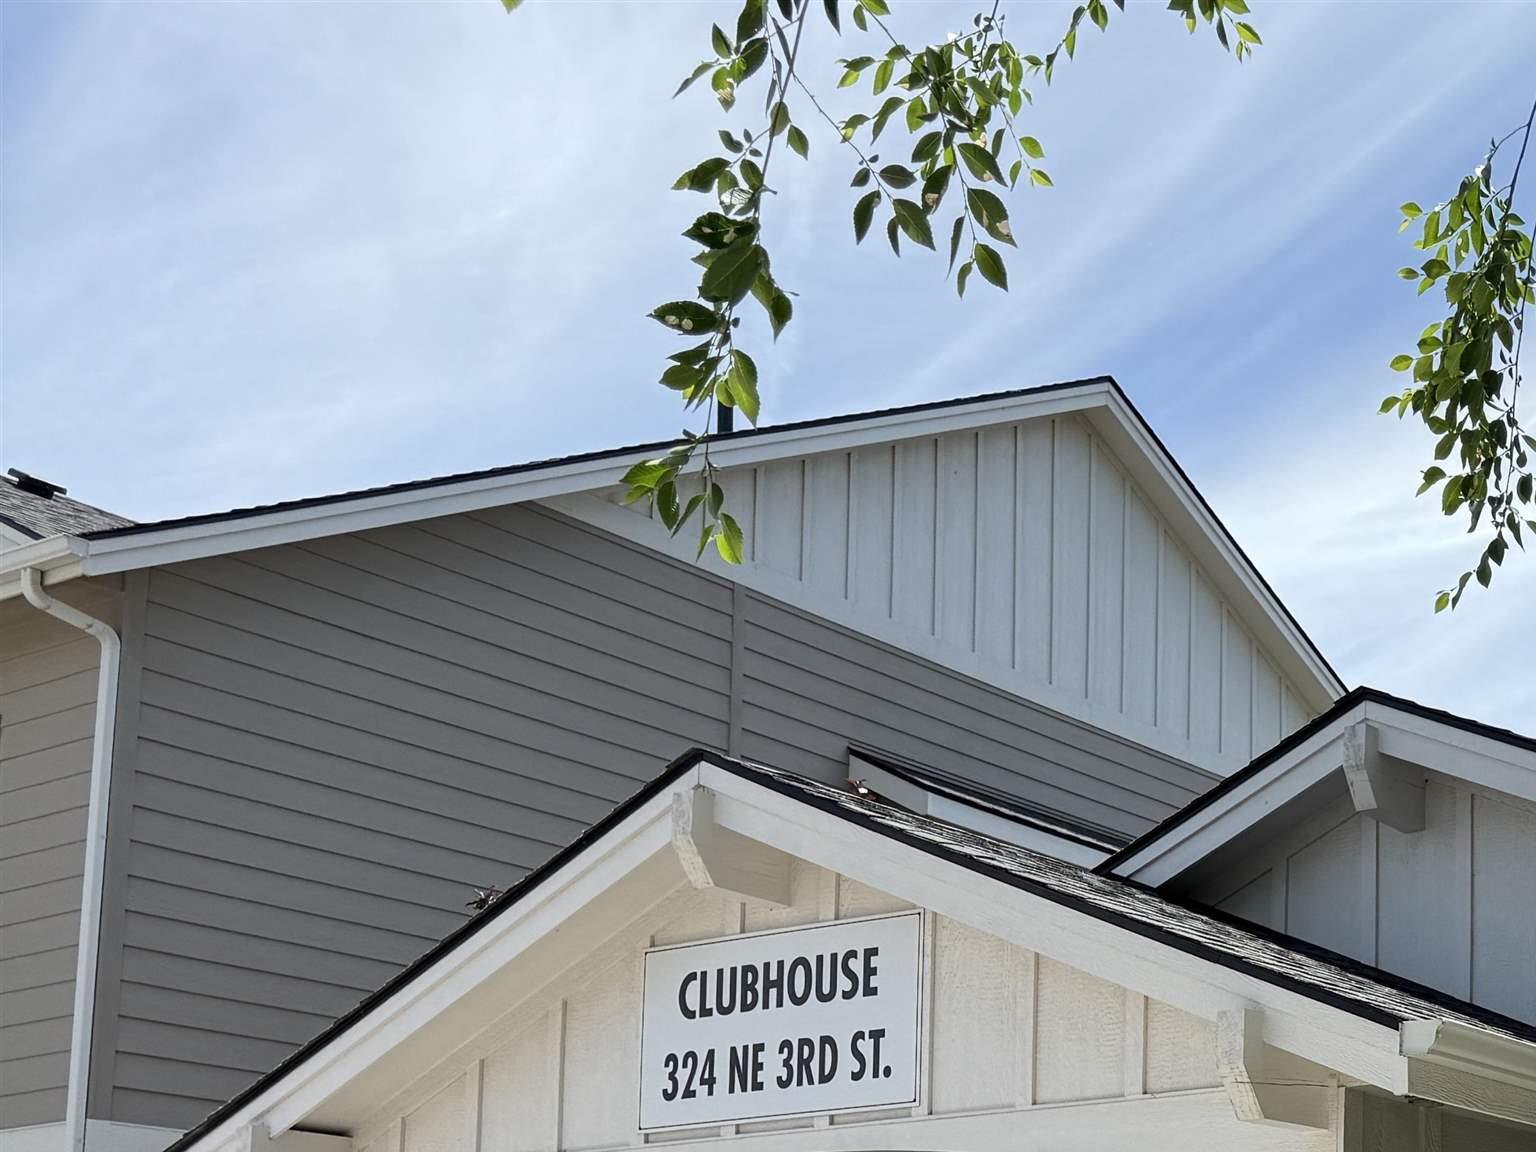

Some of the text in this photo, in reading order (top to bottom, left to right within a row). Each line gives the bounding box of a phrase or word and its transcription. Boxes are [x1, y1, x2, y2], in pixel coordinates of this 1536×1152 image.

[678, 947, 879, 1019] CLUBHOUSE
[662, 1028, 892, 1101] 324 NE 3RD ST.
